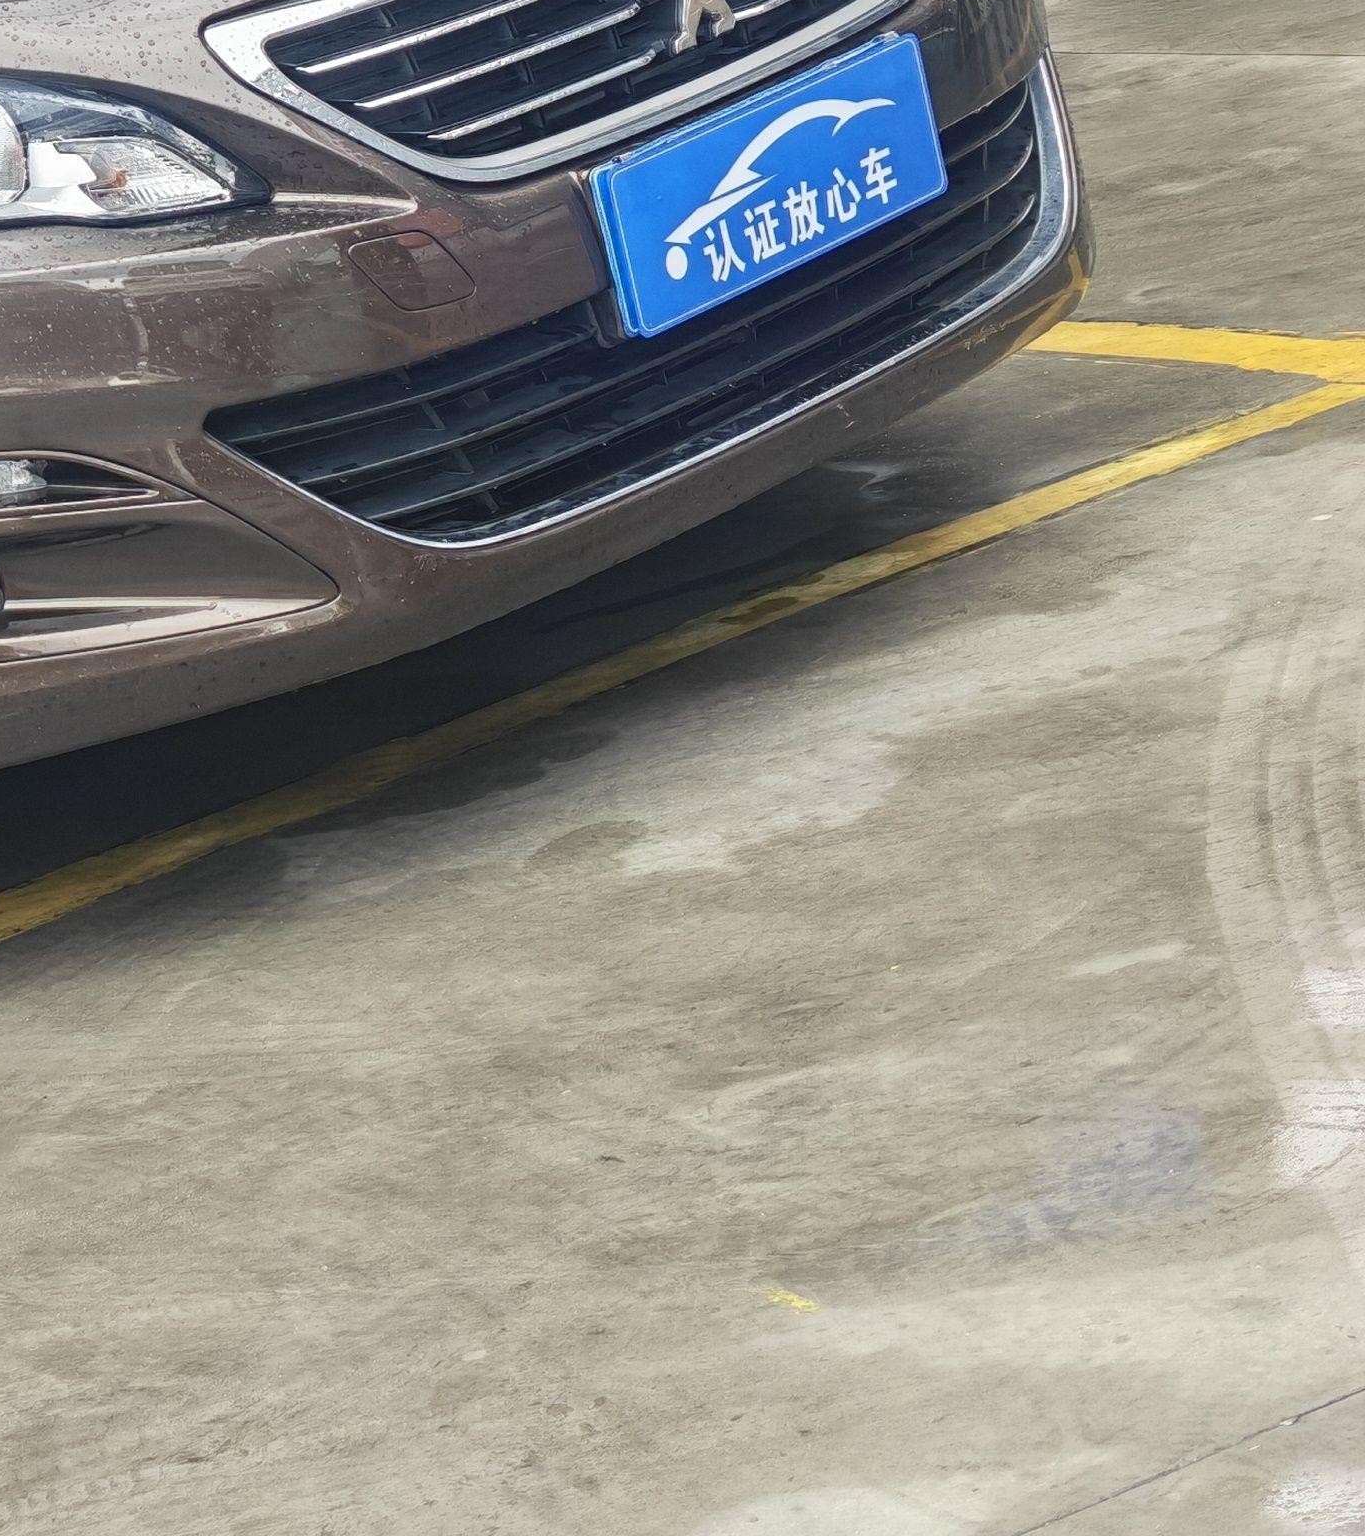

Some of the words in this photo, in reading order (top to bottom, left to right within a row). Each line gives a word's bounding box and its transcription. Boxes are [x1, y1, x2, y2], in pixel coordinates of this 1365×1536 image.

[702, 146, 900, 283] 认证放心车
